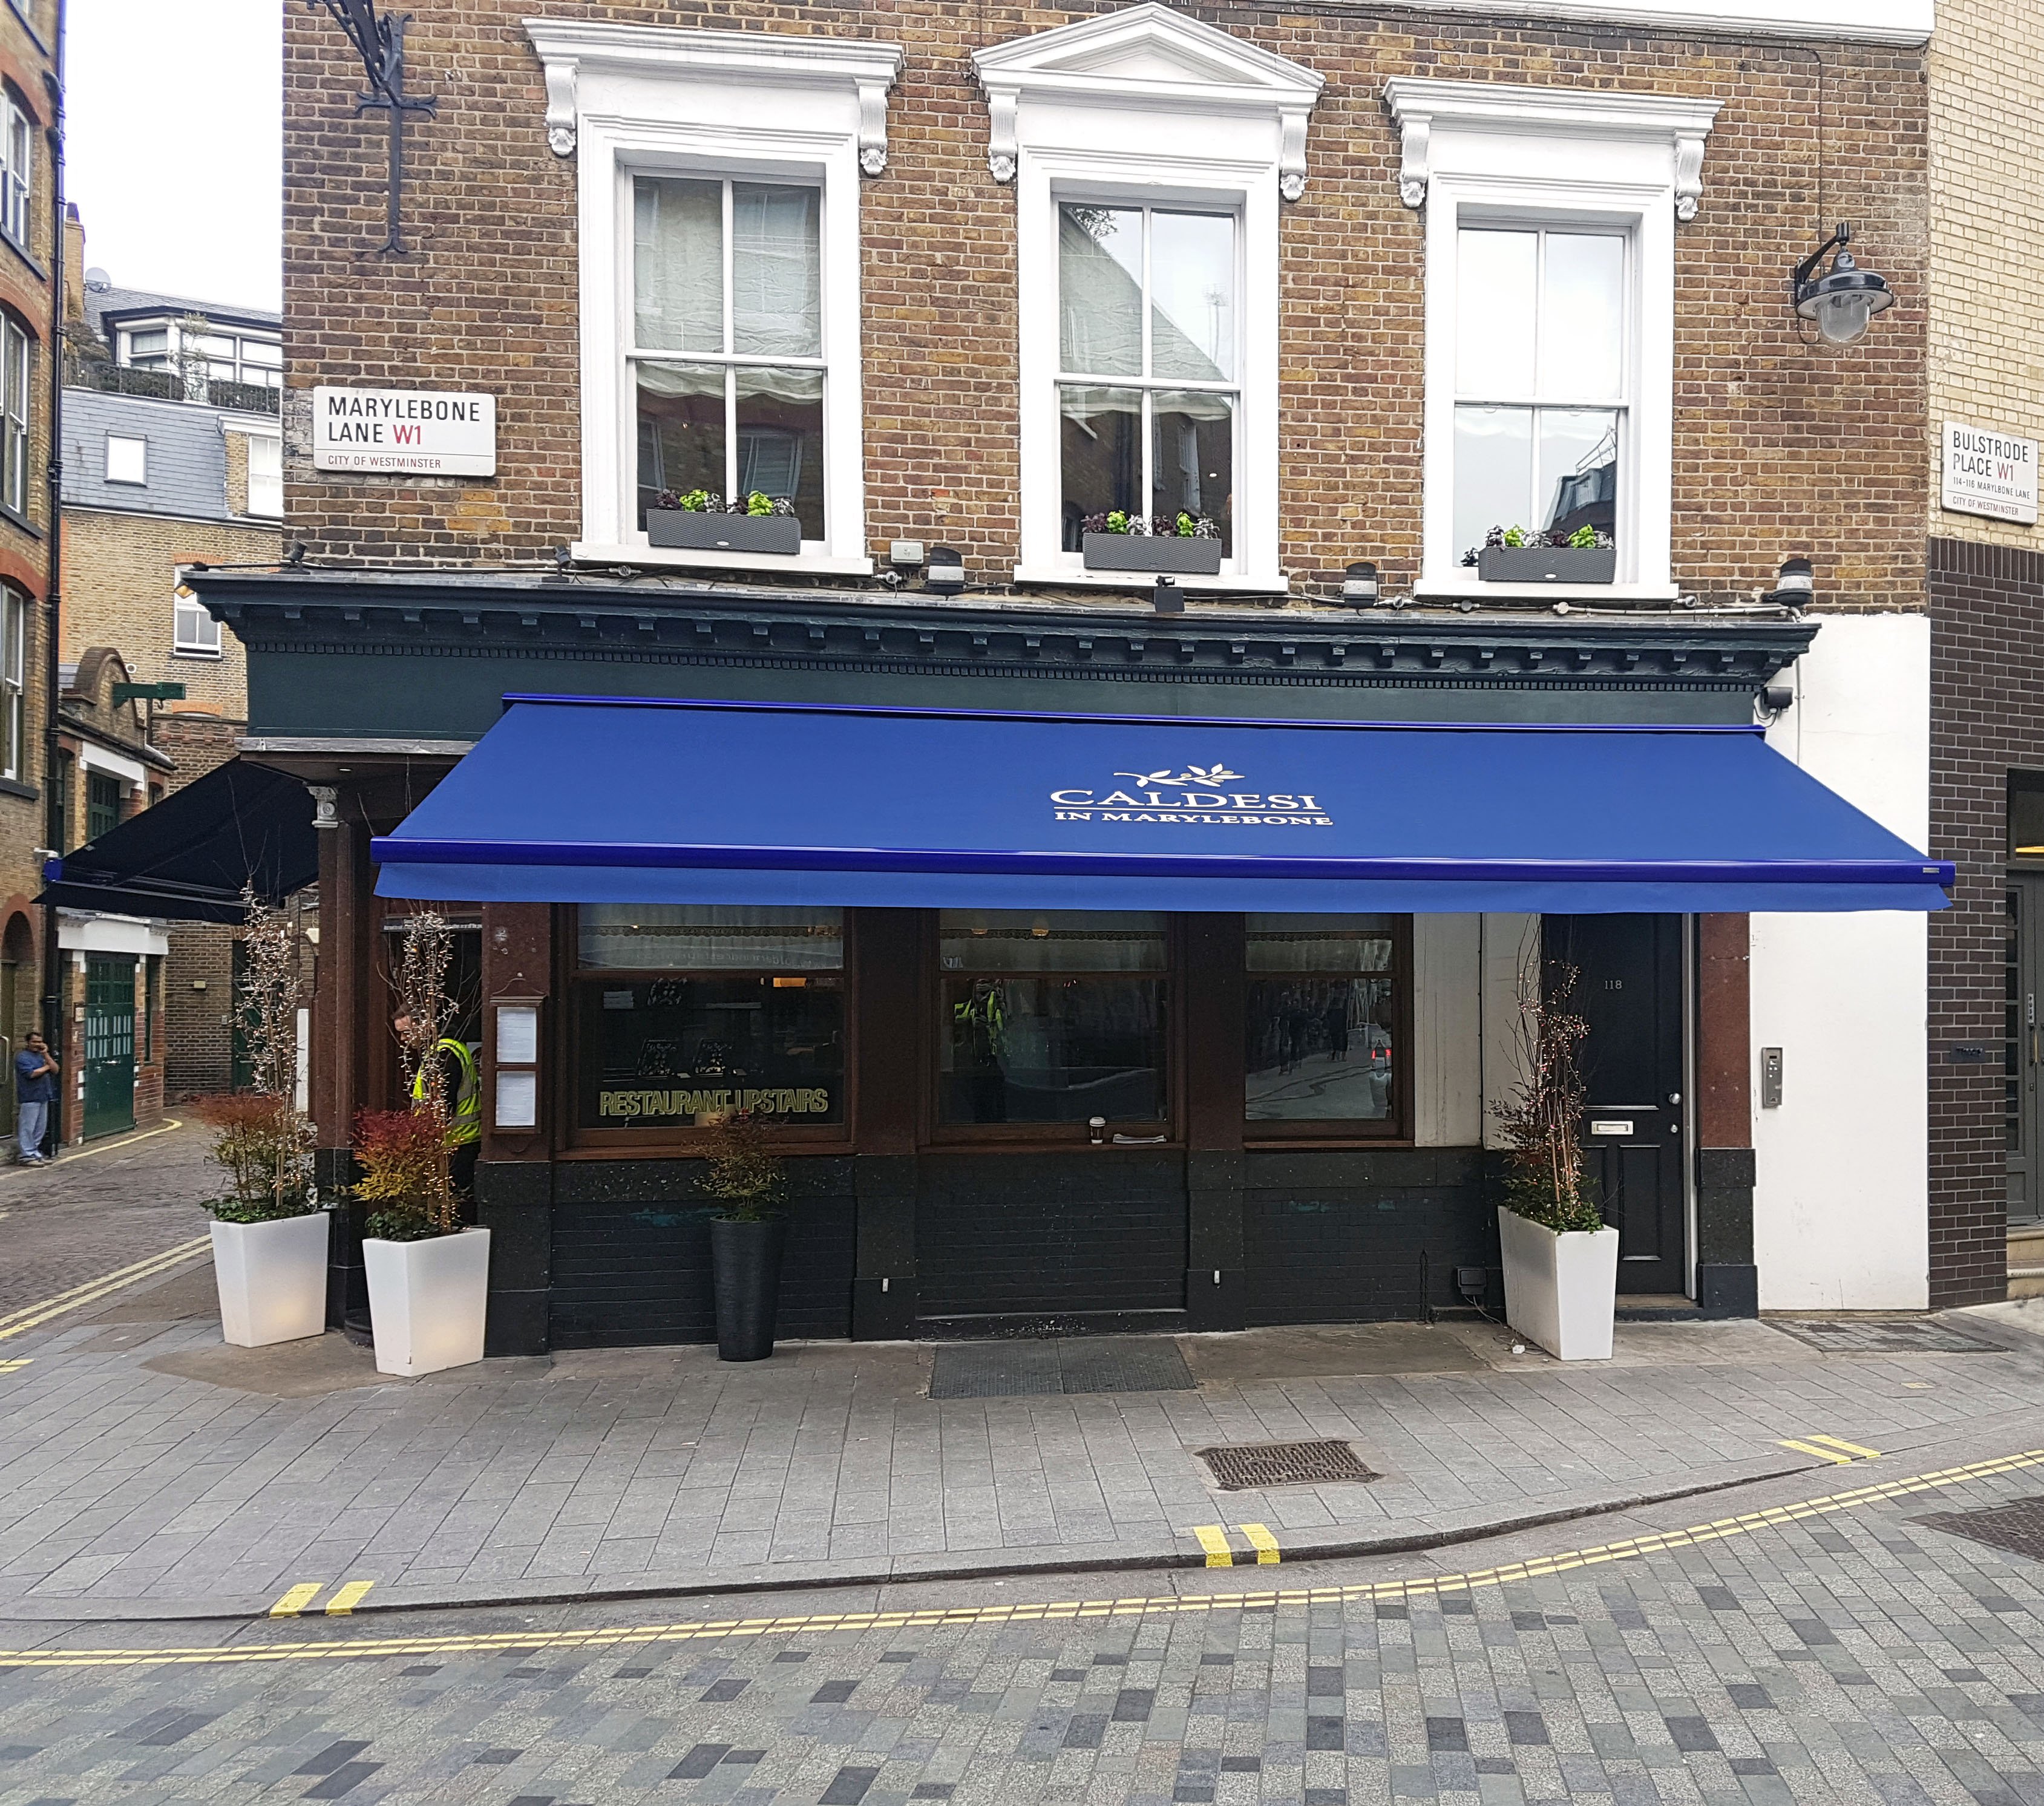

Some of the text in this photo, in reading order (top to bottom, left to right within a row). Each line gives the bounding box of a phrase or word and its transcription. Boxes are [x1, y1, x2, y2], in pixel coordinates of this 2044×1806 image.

[329, 396, 480, 422] MARYLEBONE
[329, 422, 421, 445] LANE W1
[1953, 430, 2028, 463] BULSTRODE
[328, 455, 441, 469] CITY OF WESTMINSTER
[1953, 453, 2014, 482] PLACE W1
[1953, 476, 2030, 500] 114-116 MARYLBONE LANE
[1953, 496, 2019, 516] CITY OF WESTMINSTER
[1050, 790, 1322, 810] CALDESI
[1055, 812, 1334, 825] IN MARYLEBONE
[1605, 980, 1622, 989] 118
[599, 1088, 828, 1116] RESTAURANT UPSTAIRS
